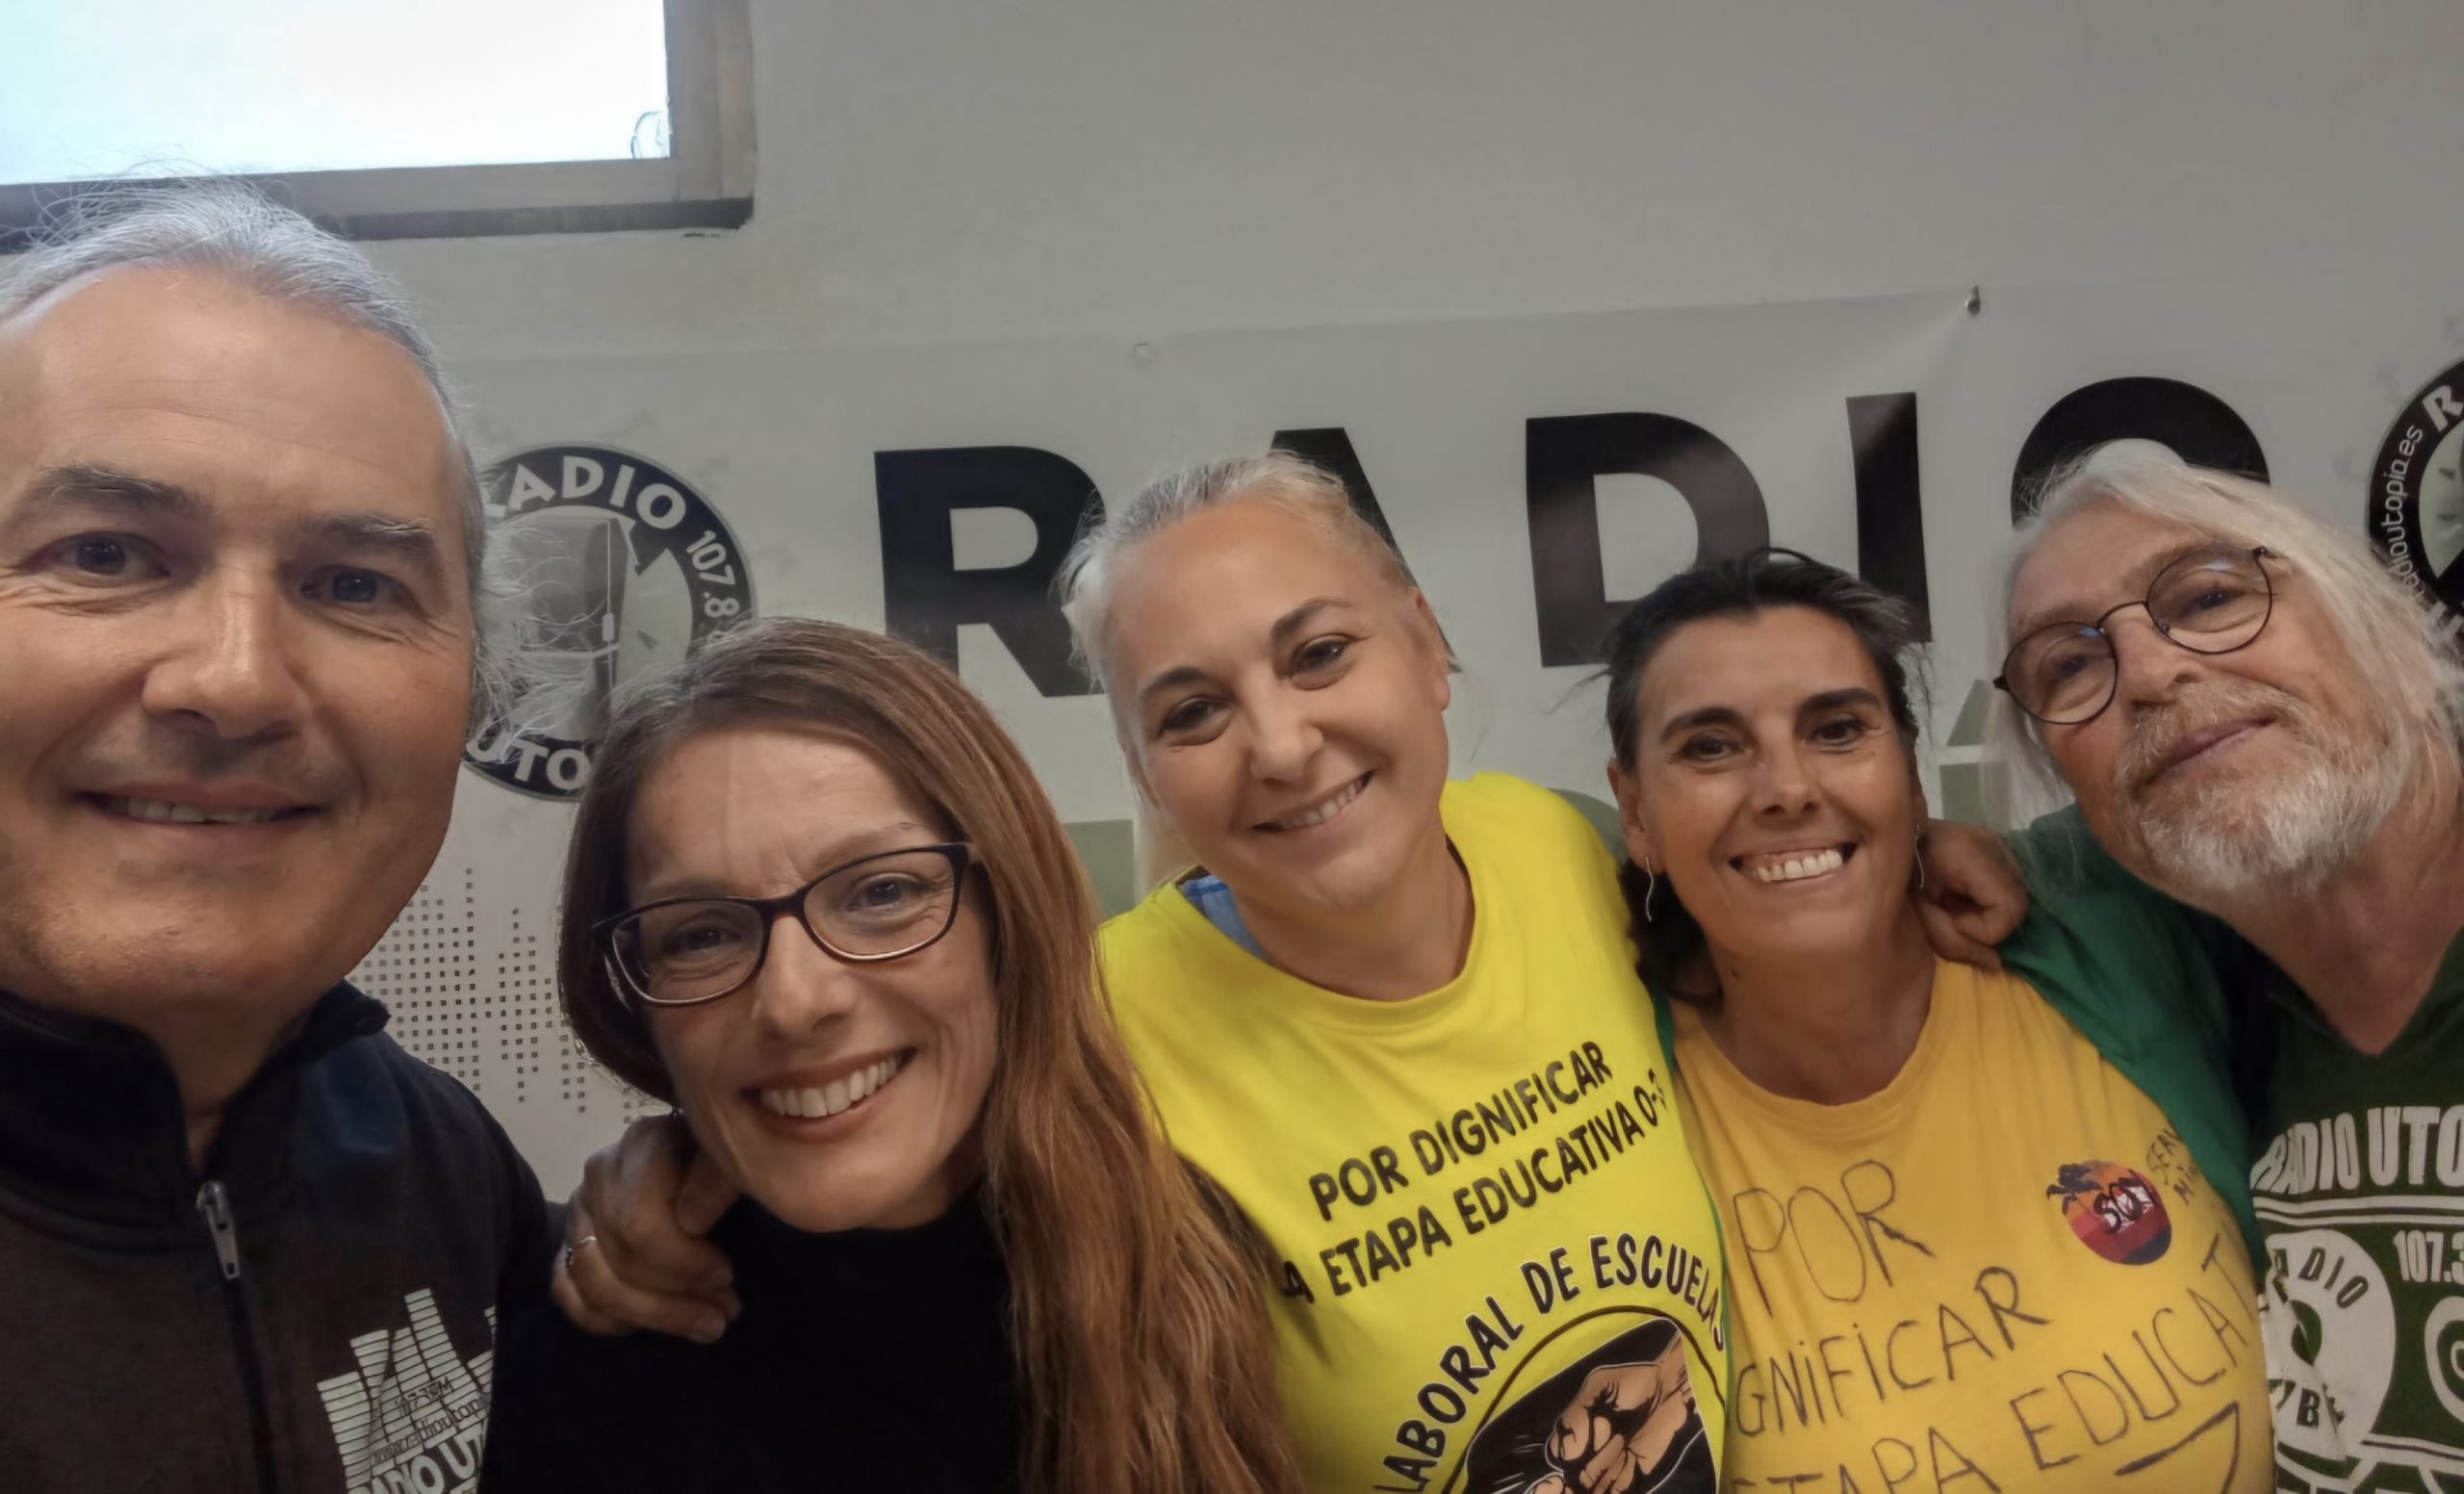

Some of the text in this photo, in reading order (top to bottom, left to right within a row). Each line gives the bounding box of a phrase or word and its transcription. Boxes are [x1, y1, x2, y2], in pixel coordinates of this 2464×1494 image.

[686, 529, 740, 619] 107.8
[1309, 1041, 1613, 1222] POR DIGNIFICAR
[2249, 1112, 2360, 1195] RADIO
[1320, 1205, 1452, 1297] ETAPA
[1452, 1098, 1646, 1235] EDUCATIVA
[1732, 1159, 1935, 1317] POR
[1521, 1247, 1581, 1315] DE
[2272, 1247, 2369, 1309] ADIO
[347, 1455, 446, 1494] DIO
[1732, 1427, 2000, 1494] TPA
